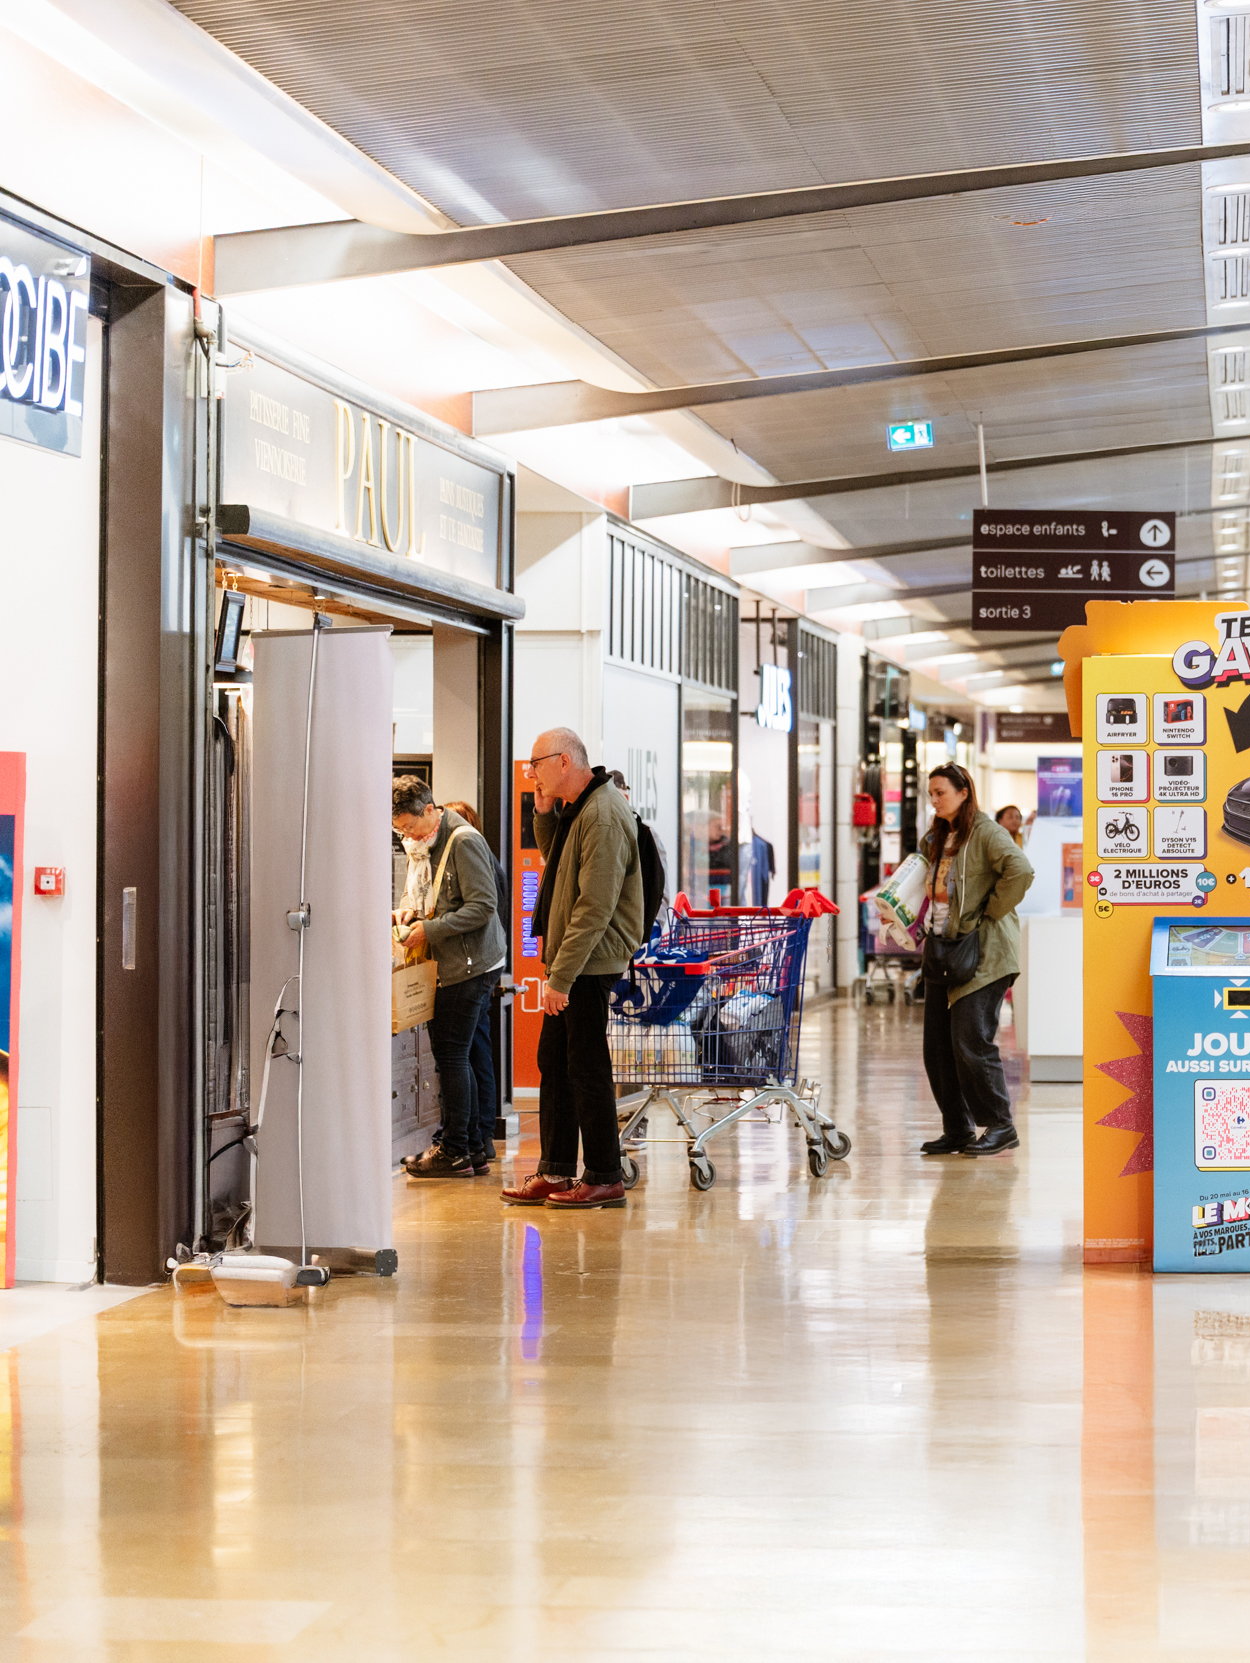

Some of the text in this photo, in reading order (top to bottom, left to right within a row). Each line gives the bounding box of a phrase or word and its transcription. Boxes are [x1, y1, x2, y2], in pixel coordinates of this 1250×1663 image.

[292, 409, 311, 444] FINE
[334, 399, 426, 562] PAUL
[980, 522, 1086, 537] espace enfants
[980, 564, 1045, 578] toilettes
[979, 605, 1031, 618] sortie 3
[1114, 869, 1188, 879] 2 MILLIONS
[1122, 880, 1181, 890] D'EUROS
[1197, 878, 1215, 886] 10€
[1165, 1060, 1215, 1073] AUSSI
[1192, 1202, 1222, 1228] LE
[1193, 1223, 1250, 1240] À VOS MARQUES,
